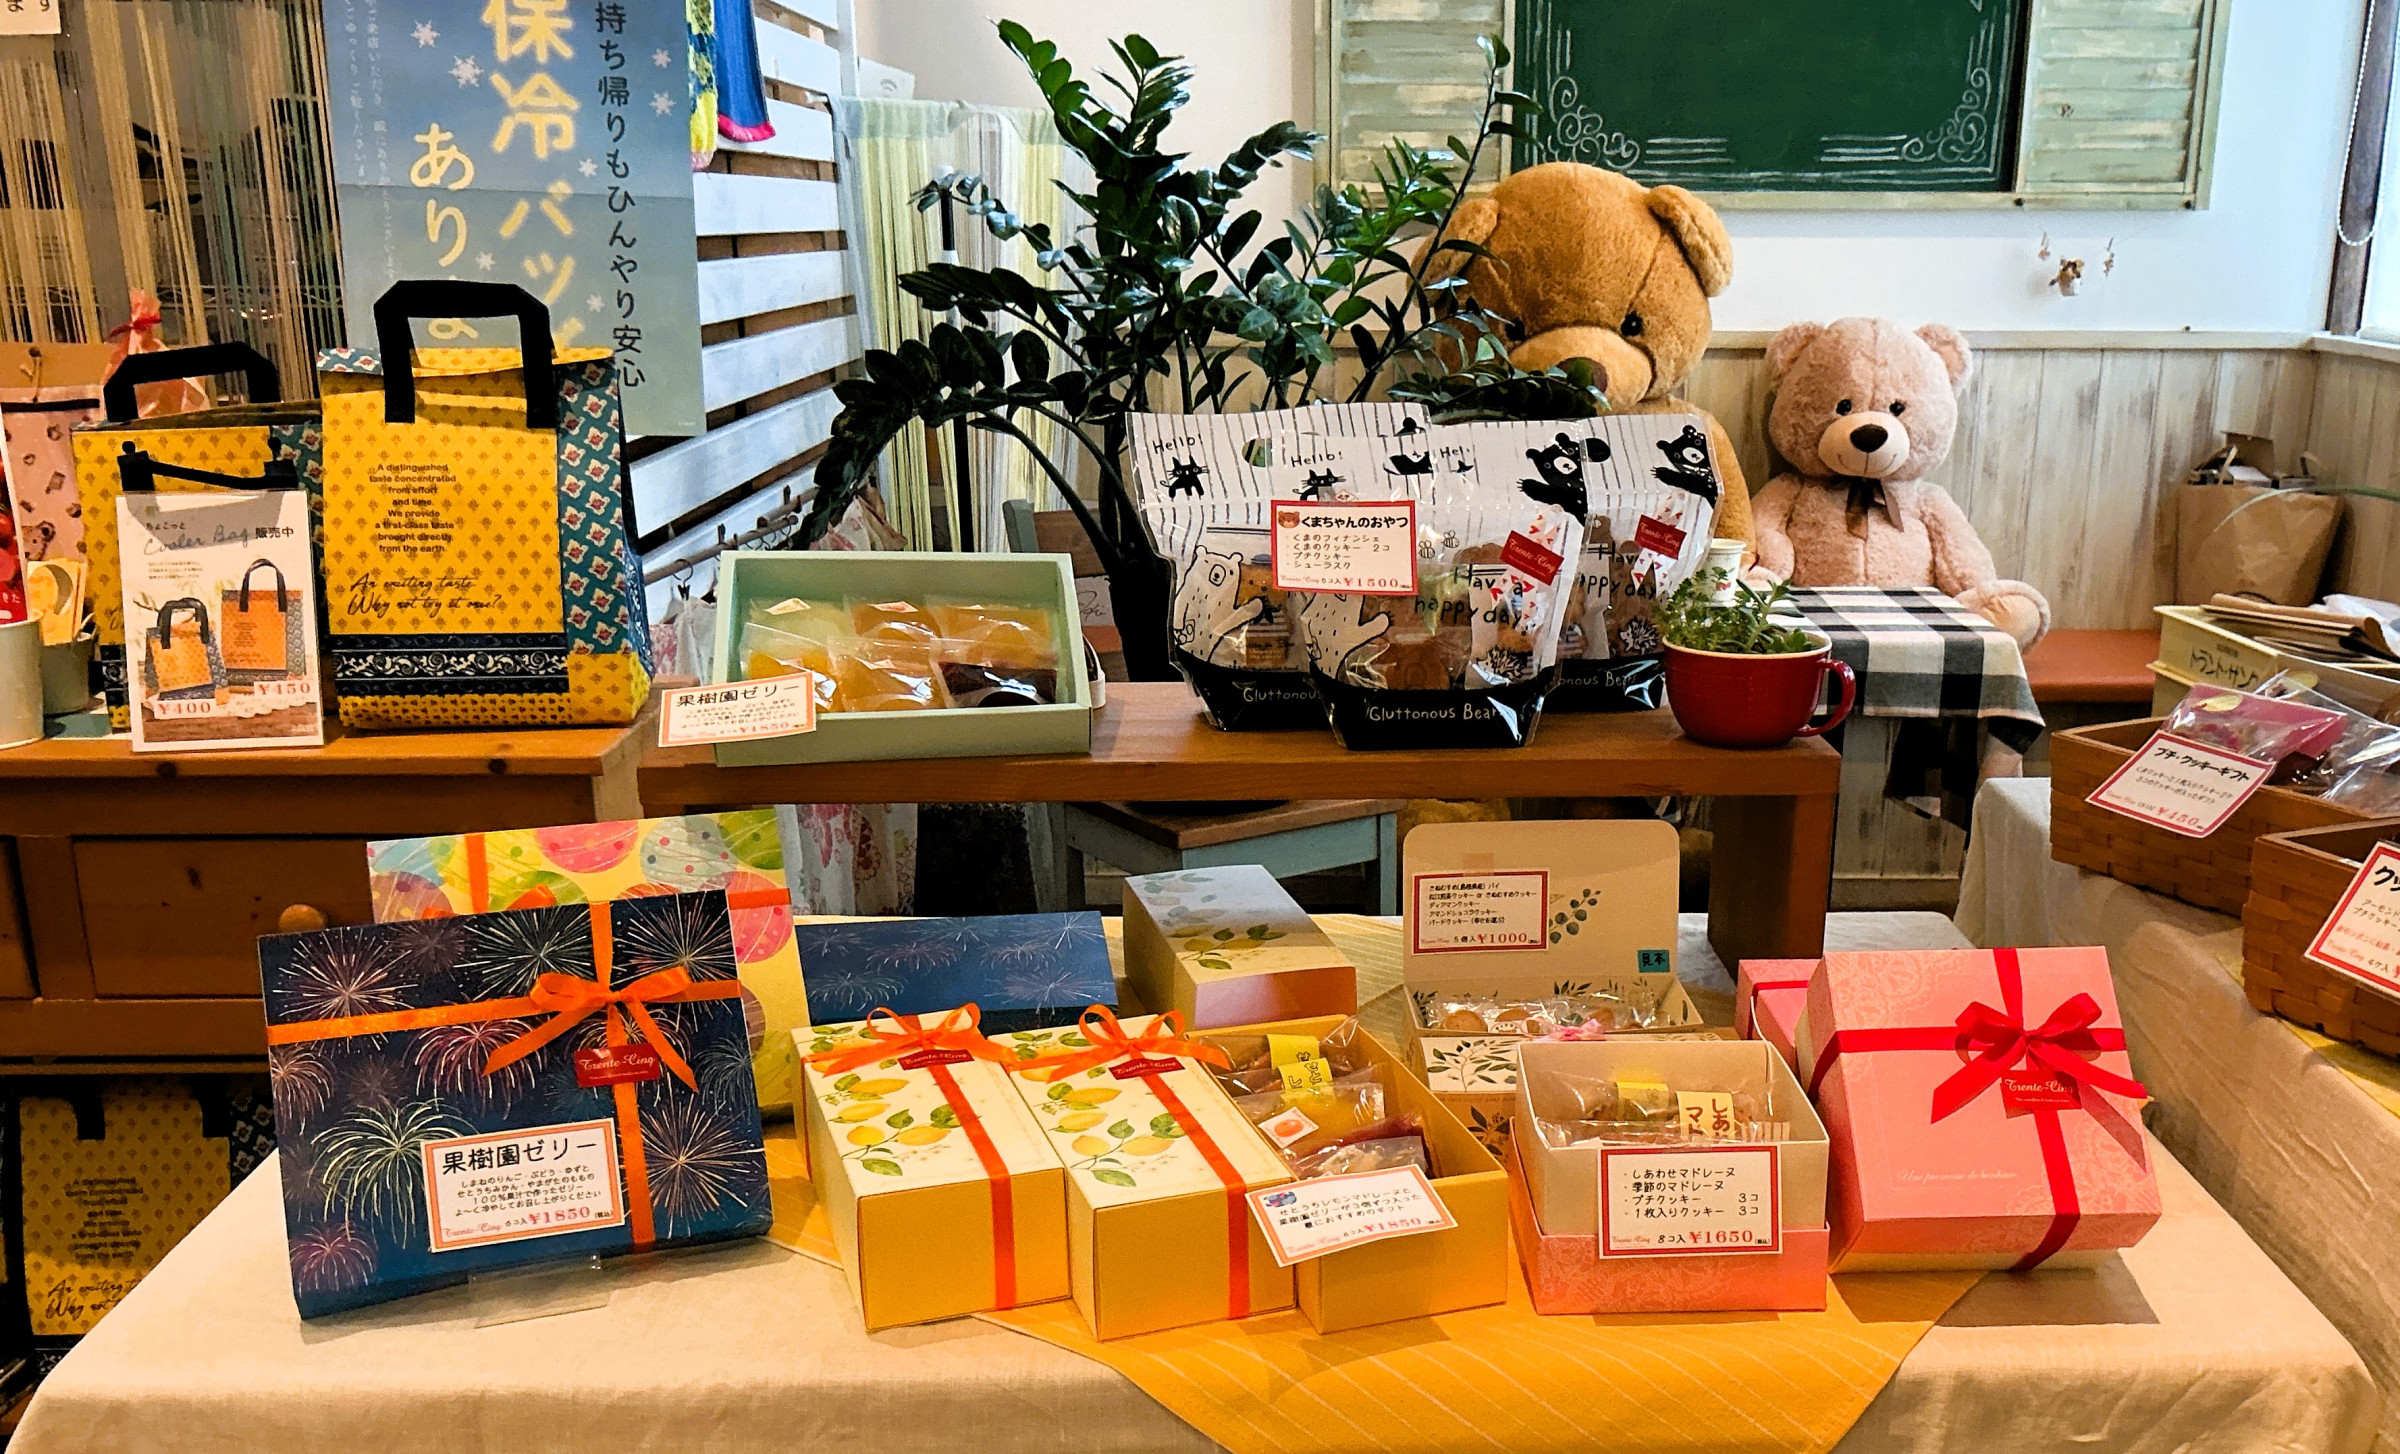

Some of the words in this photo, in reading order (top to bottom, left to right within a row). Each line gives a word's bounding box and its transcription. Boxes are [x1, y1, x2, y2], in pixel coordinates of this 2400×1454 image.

[481, 0, 587, 349] 保冷バッ
[393, 475, 457, 483] concentrated
[405, 509, 440, 519] provide
[1301, 516, 1409, 529] くまちゃんのおやつ
[254, 526, 295, 539] 販売中
[378, 532, 415, 542] brought
[1293, 533, 1380, 543] くまのフィナンシェ
[1293, 543, 1361, 552] くまのクッキー
[1293, 551, 1352, 560] プチクッキー
[1293, 560, 1351, 570] シューラスク
[1343, 577, 1399, 588] ¥1500
[1453, 564, 1496, 590] Hav
[676, 684, 800, 707] 果樹園ゼリー
[158, 701, 211, 715] ¥400
[1369, 705, 1456, 722] Gluttonous
[1463, 702, 1503, 720] Bear
[1477, 932, 1527, 944] ¥1000
[1641, 952, 1666, 967] 見本
[579, 1053, 656, 1071] Trente-Cinq
[1711, 1098, 1731, 1137] しあ
[442, 1137, 597, 1175] 果樹園ゼリー
[1632, 1166, 1736, 1179] しあわせマドレーヌ
[1632, 1180, 1725, 1193] 季節のマドレーヌ
[1632, 1194, 1702, 1206] プチクッキー
[528, 1205, 591, 1225] ¥1850
[1635, 1207, 1725, 1219] 1枚入りクッキー
[1689, 1229, 1753, 1244] ¥1650
